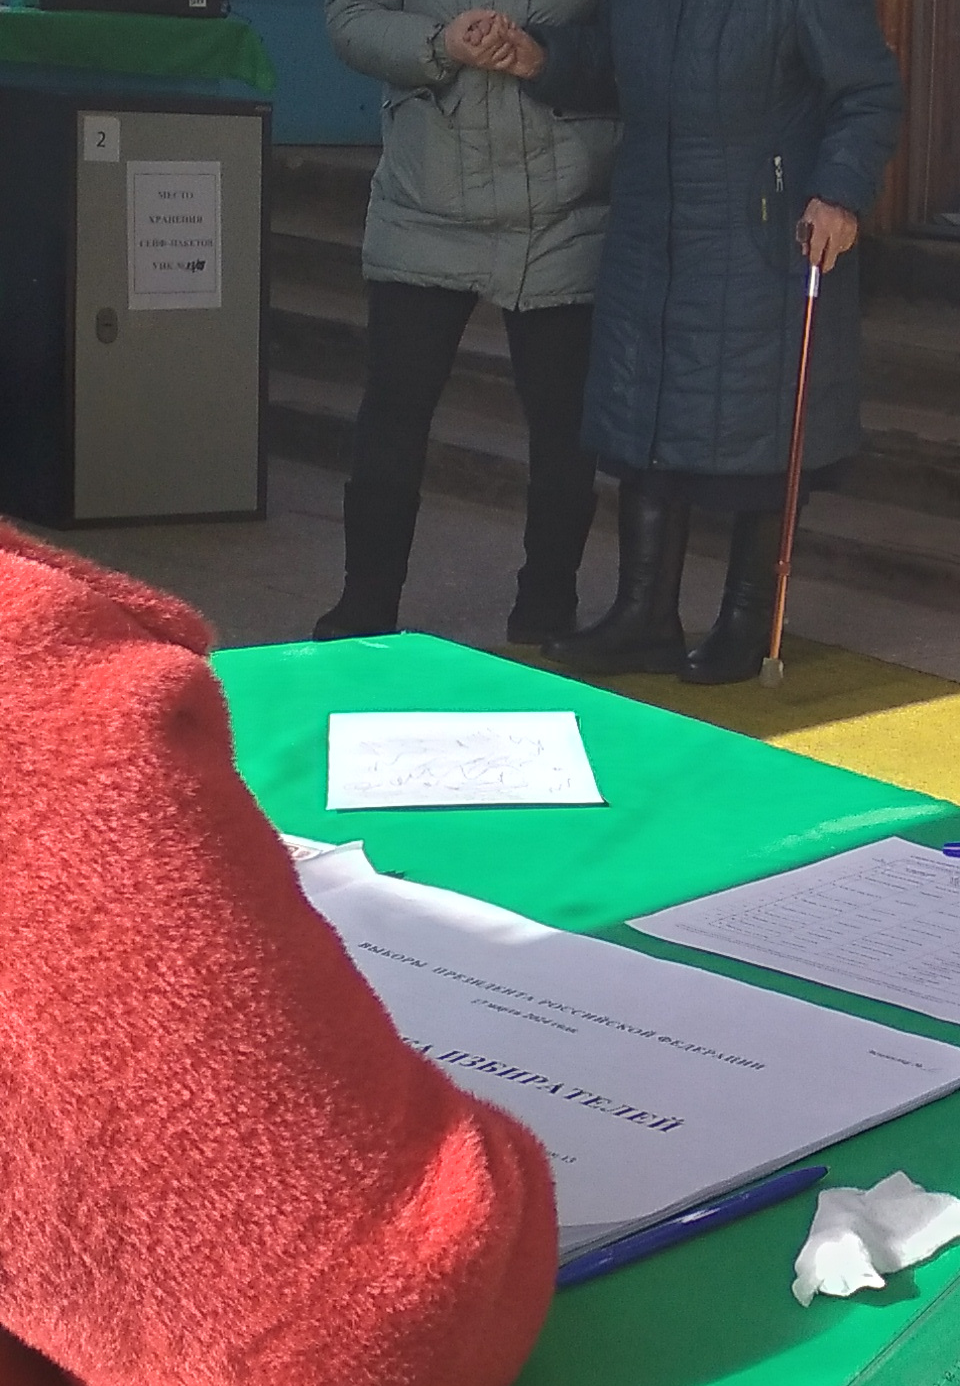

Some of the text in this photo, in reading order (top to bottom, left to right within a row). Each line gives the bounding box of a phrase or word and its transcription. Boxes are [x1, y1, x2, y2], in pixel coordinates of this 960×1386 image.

[97, 130, 106, 148] 2
[358, 941, 766, 1071] ВЫБОРЫ ПРЕЗИДЕНТА РОССИЙСКОЙ ФЕДЕРАЦИИ
[437, 1049, 685, 1133] ИЗБИРАТЕЛЕЙ
